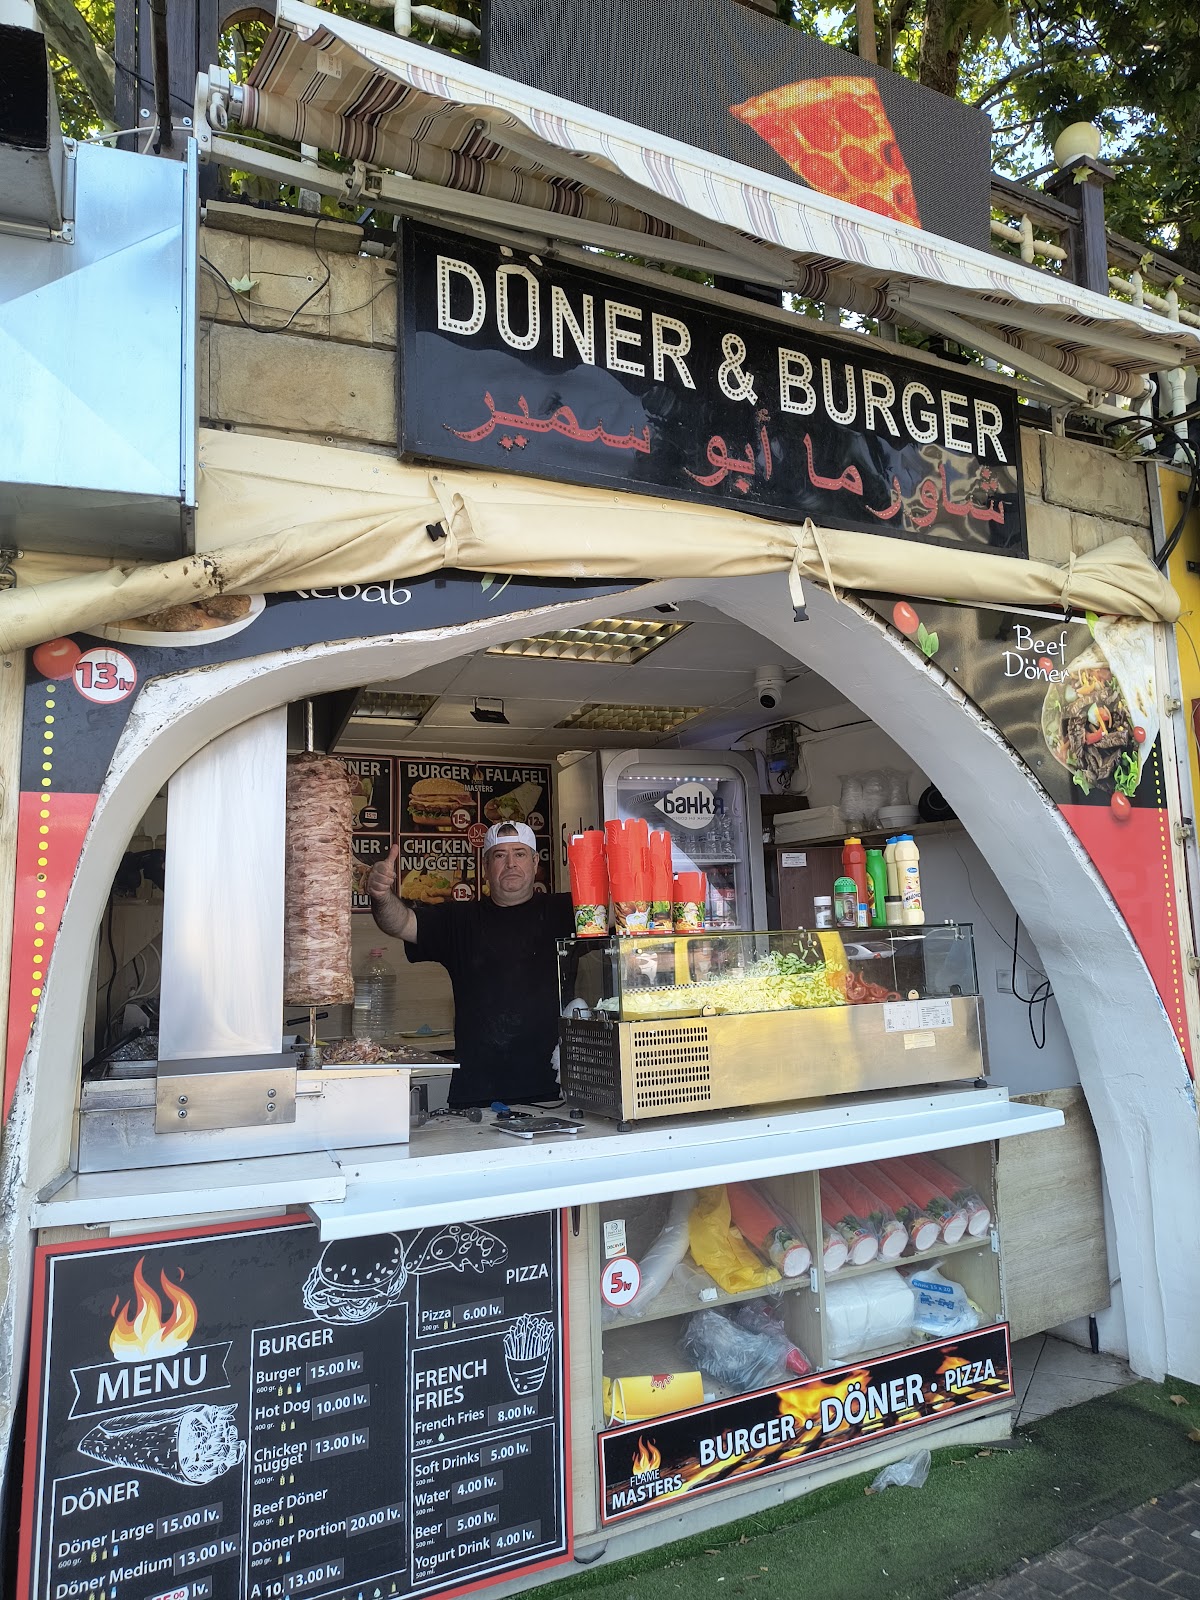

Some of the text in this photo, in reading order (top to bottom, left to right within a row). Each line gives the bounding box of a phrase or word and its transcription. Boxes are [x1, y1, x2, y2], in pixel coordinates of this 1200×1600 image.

[437, 246, 1008, 463] DÖNER & BURGER
[442, 391, 651, 453] سمير
[275, 579, 412, 606] ebab
[1013, 624, 1067, 665] Beef
[1002, 651, 1070, 683] Döner
[407, 764, 546, 784] BURGER FALAFEL
[465, 784, 493, 793] MASTERS
[403, 839, 473, 854] CHICKEN
[401, 856, 476, 871] NUGGETS
[506, 1263, 549, 1284] PIZZA
[421, 1304, 502, 1322] Pizza 6.00 lv.
[258, 1328, 334, 1357] BURGER
[96, 1354, 208, 1404] MENU
[256, 1359, 361, 1384] Burger 15.00 lv.
[415, 1359, 487, 1391] FRENCH
[255, 1393, 367, 1420] Hot Dog 10.00 lv.
[415, 1385, 464, 1413] FRIES
[699, 1358, 997, 1467] BURGER DÖNER PIZZA
[415, 1404, 536, 1434] French Fries 8.00 lv.
[254, 1433, 366, 1462] Chicken 13.00 lv.
[415, 1443, 529, 1478] Soft Drinks 5.00 lv.
[254, 1452, 303, 1475] nugget
[414, 1476, 497, 1507] Water 4.00 lv.
[611, 1474, 683, 1511] MASTERS
[629, 1469, 661, 1488] FLAME
[61, 1479, 140, 1516] DÖNER
[253, 1488, 329, 1517] Beef Döner
[57, 1508, 220, 1558] Döner Large 15.00 lv.
[251, 1508, 401, 1556] Döner Portion 20.00 lv.
[415, 1511, 497, 1539] Beer 5.00 lv.
[414, 1529, 535, 1570] Yogurt Drink 4.00 lv.
[55, 1540, 237, 1600] Döner Medium 13.00 lv.
[288, 1568, 324, 1590] 13.00
[326, 1564, 341, 1578] lv.
[192, 1583, 209, 1598] lv.
